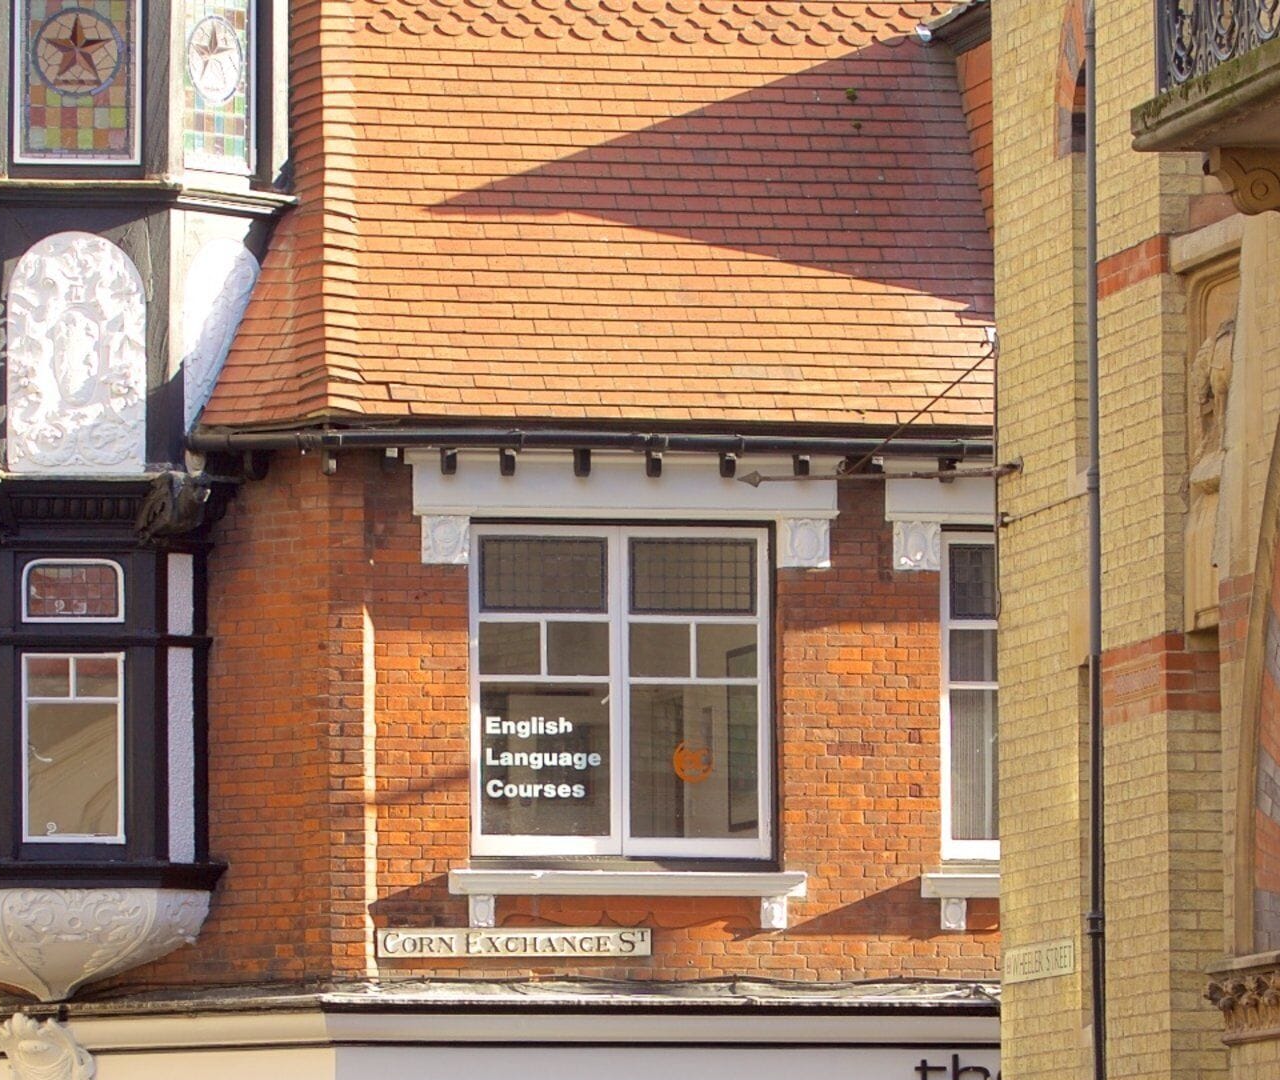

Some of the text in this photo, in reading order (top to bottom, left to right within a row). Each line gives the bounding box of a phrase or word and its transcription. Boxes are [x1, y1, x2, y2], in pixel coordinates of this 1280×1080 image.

[485, 716, 573, 738] English
[485, 748, 602, 770] Language
[486, 779, 586, 798] Courses
[383, 931, 455, 954] CORN
[465, 931, 611, 954] EXCHANGE
[1012, 950, 1044, 976] WHEELER
[1046, 945, 1072, 971] STREET
